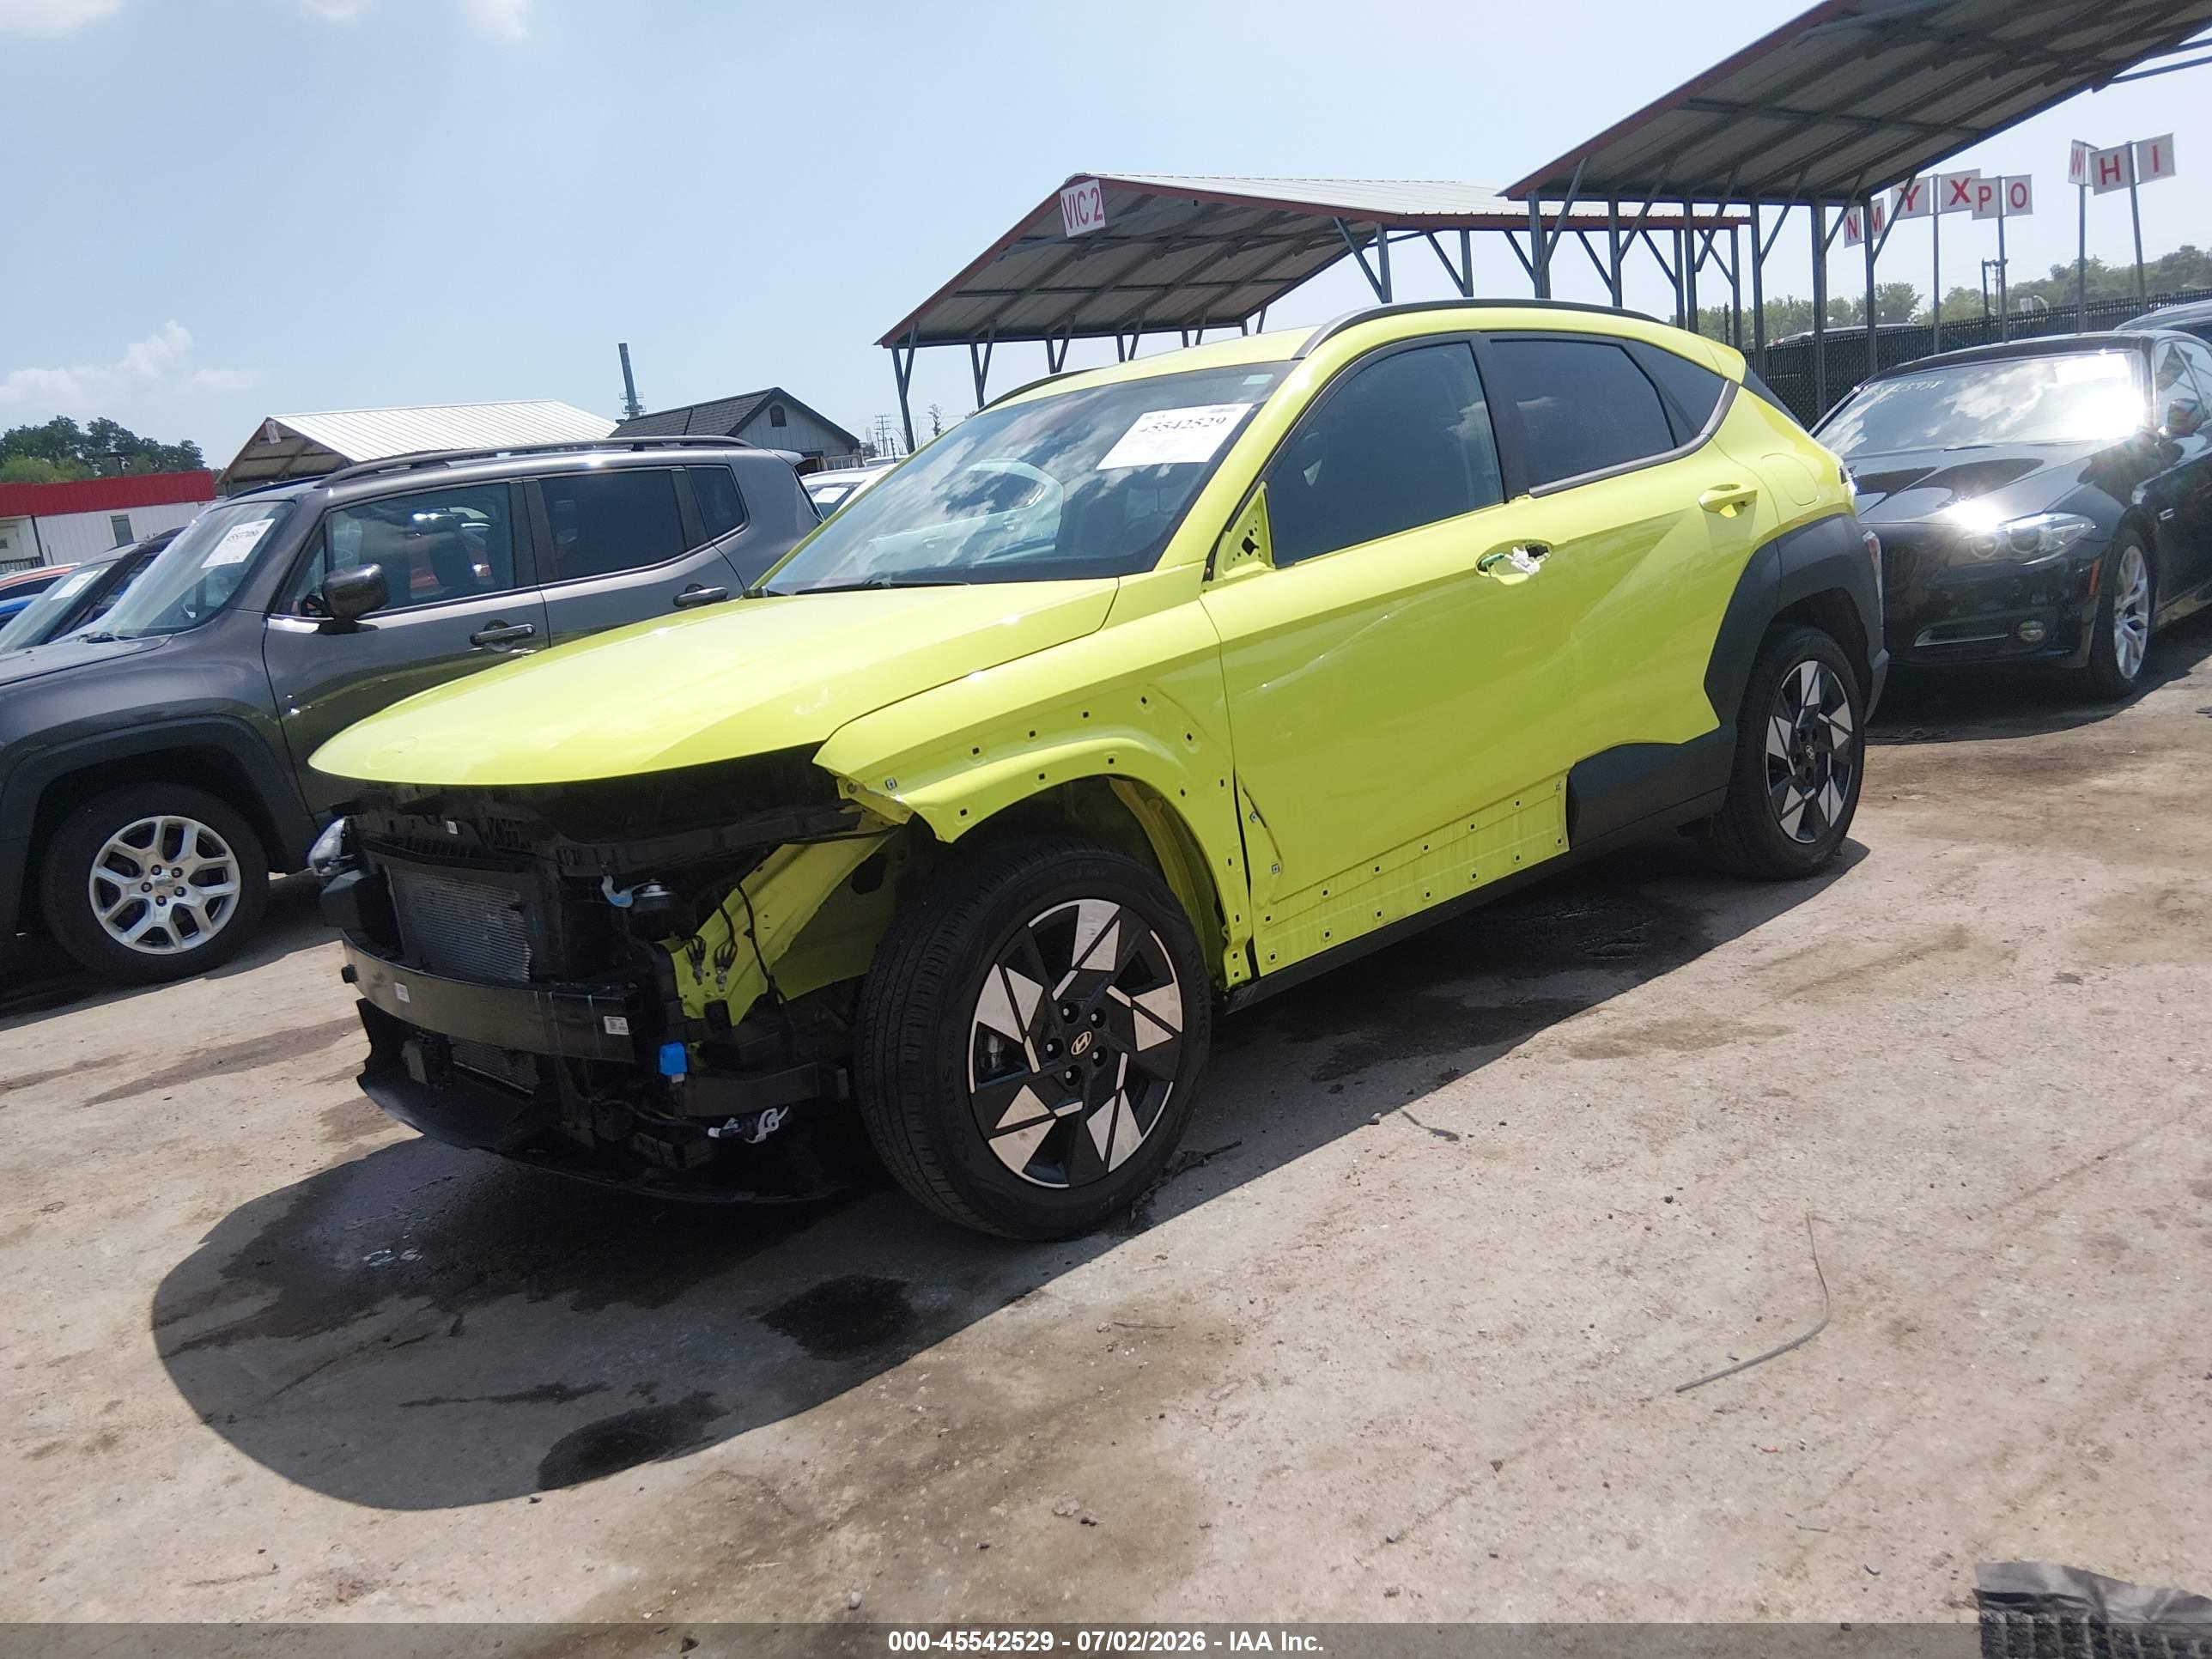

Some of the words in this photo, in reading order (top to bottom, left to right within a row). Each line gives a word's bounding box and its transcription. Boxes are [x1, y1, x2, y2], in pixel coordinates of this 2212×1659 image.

[2100, 154, 2121, 185] H
[2152, 144, 2160, 173] I
[1062, 191, 1089, 229] VIC
[1091, 186, 1103, 222] 2
[1899, 185, 1921, 211] Y
[1949, 177, 1971, 206] X
[1978, 185, 1992, 211] P
[1847, 214, 1858, 240] N
